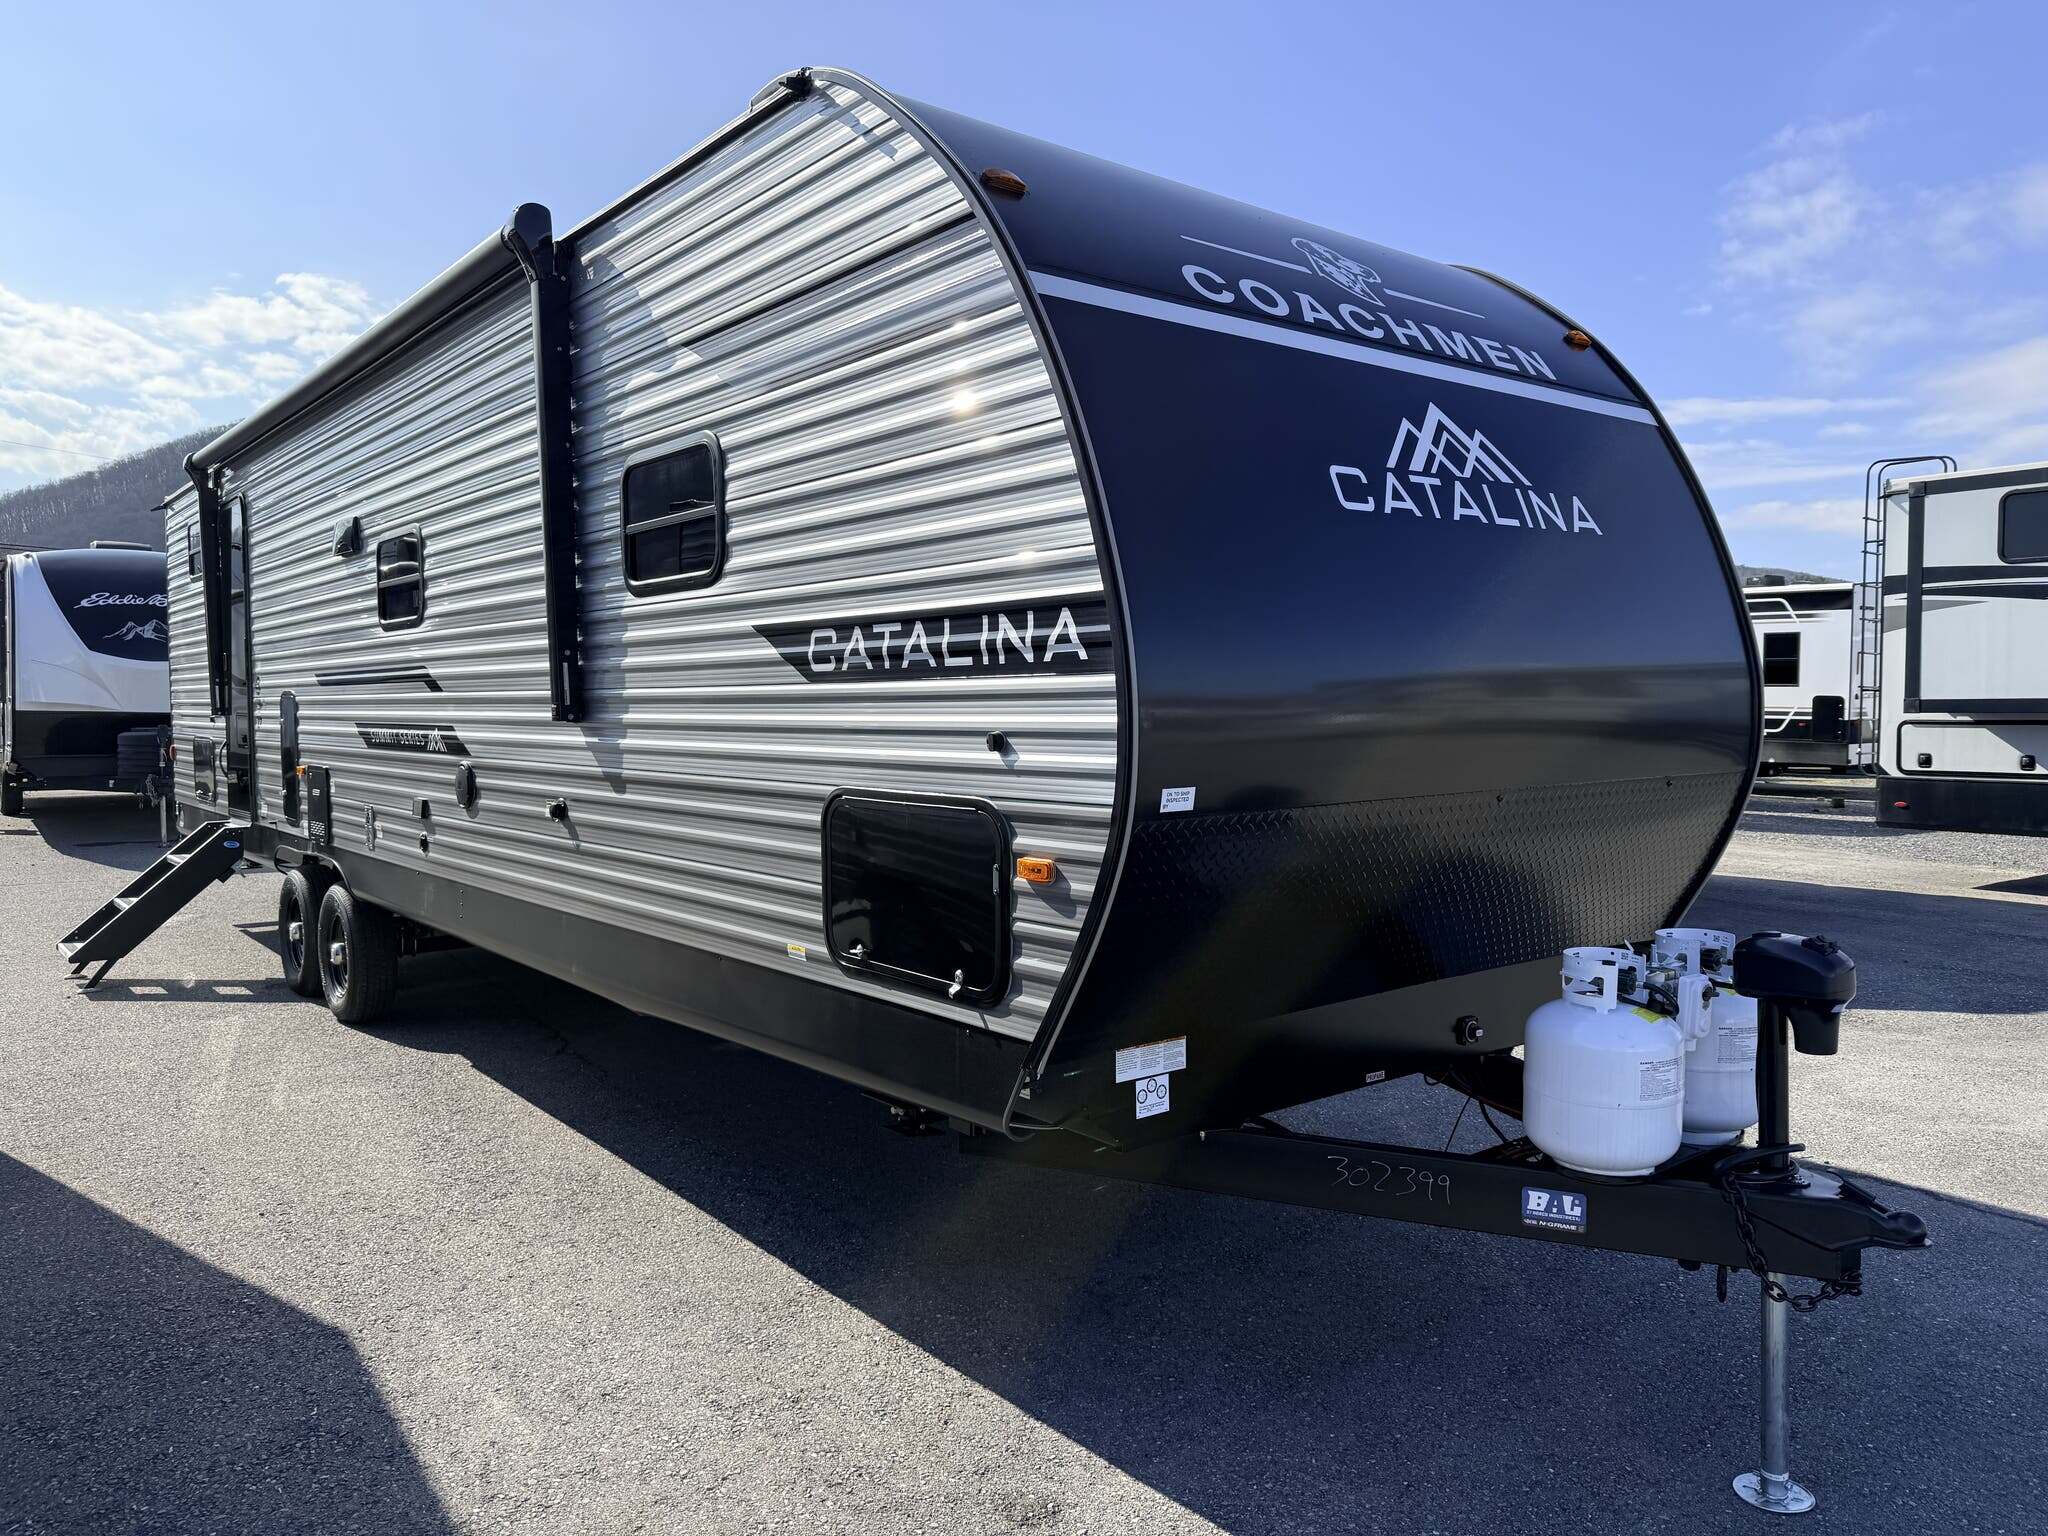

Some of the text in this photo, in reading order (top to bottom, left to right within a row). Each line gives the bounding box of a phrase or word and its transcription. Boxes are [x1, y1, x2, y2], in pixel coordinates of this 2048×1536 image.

[1181, 264, 1557, 380] COACHMEN
[1329, 464, 1603, 536] CATALINA
[73, 592, 145, 608] Eddie
[807, 607, 1089, 673] CATALINA
[370, 728, 425, 746] SUMMIT SERIES
[1327, 1155, 1451, 1205] 302399
